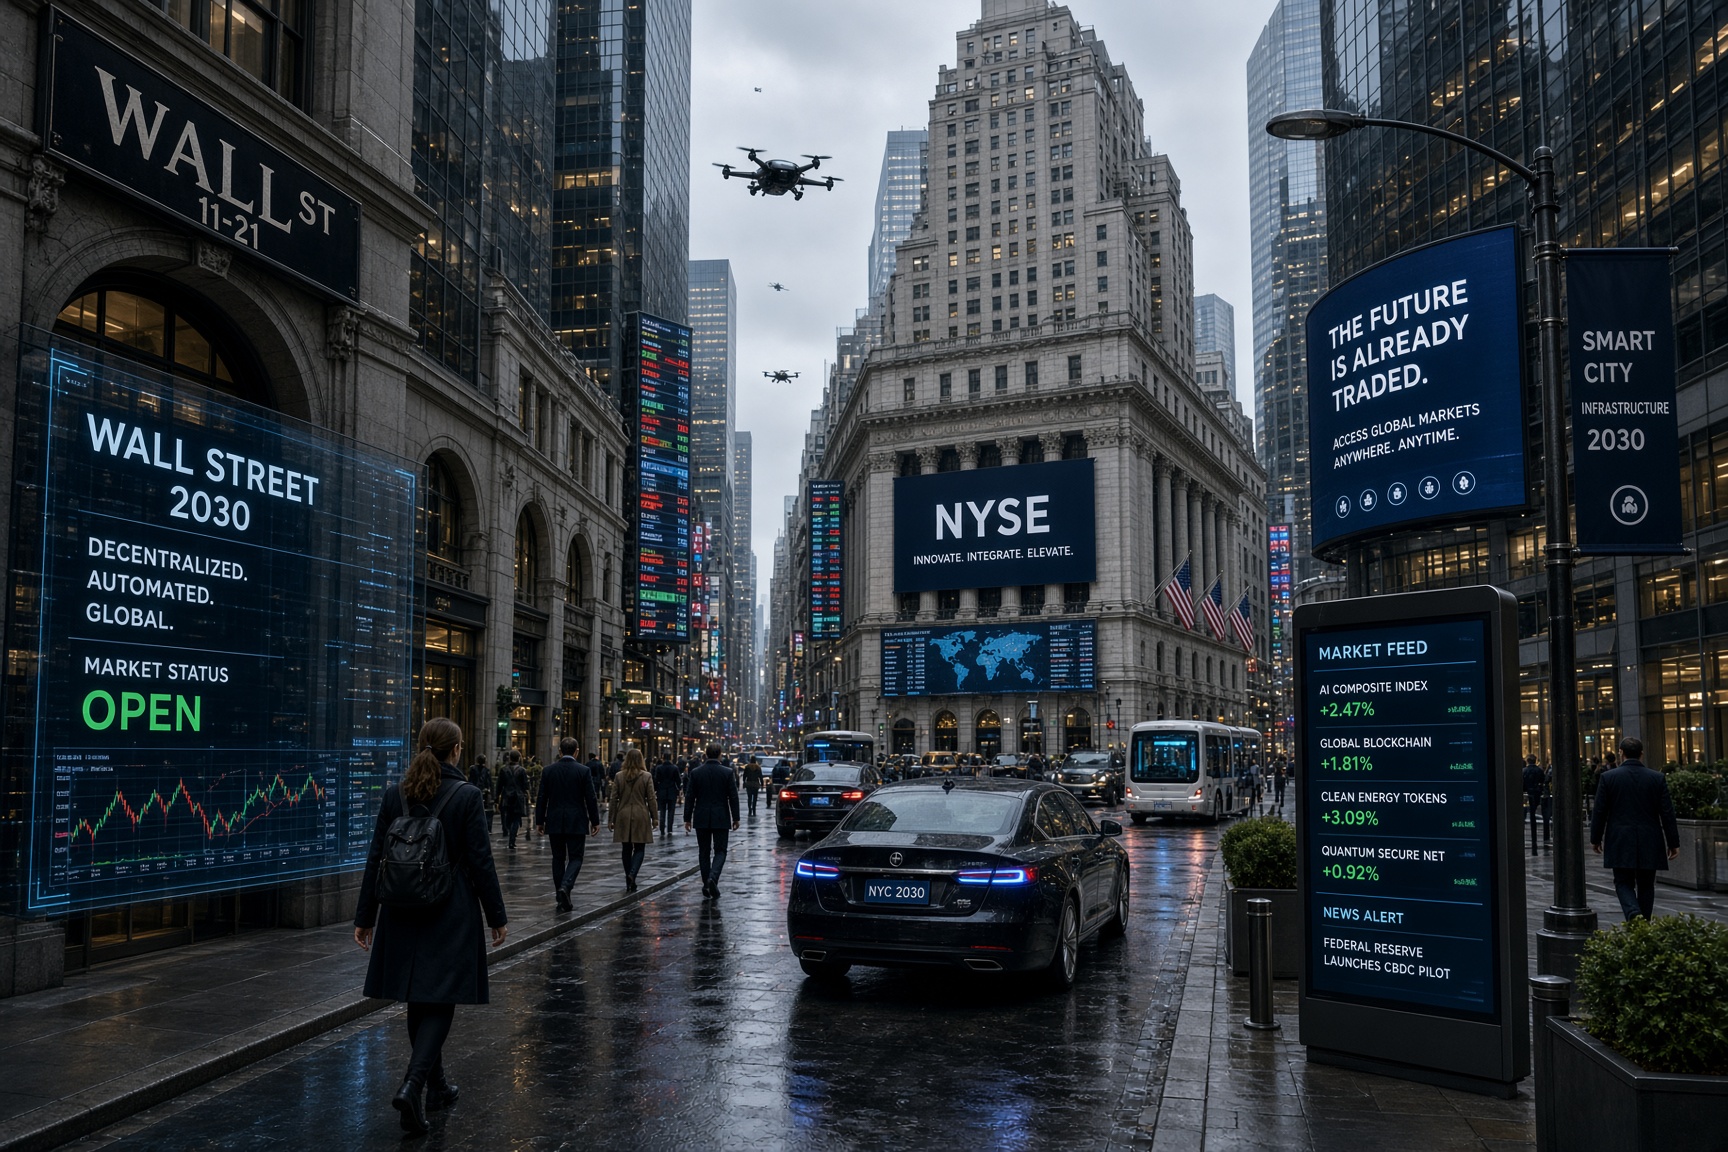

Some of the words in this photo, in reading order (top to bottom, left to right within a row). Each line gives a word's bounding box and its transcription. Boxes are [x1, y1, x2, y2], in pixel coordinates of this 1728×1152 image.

[95, 66, 292, 234] WALL
[298, 191, 335, 235] ST
[199, 197, 259, 249] 11-21
[1329, 317, 1363, 349] THE
[1370, 279, 1467, 331] FUTURE
[1332, 356, 1347, 380] IS
[1353, 314, 1468, 372] ALREADY
[1583, 331, 1655, 351] SMART
[1584, 363, 1633, 383] CITY
[1333, 363, 1427, 412] TRADED.
[1582, 402, 1669, 414] INFRASTRUCTURE
[1334, 429, 1368, 450] ACCESS
[1371, 416, 1415, 437] GLOBAL
[1419, 404, 1480, 425] MARKETS
[1334, 444, 1394, 469] ANYWHERE.
[1399, 428, 1459, 451] ANYTIME.
[1588, 429, 1645, 451] 2030
[87, 413, 194, 475] WALL
[206, 449, 318, 505] STREET
[170, 486, 250, 531] 2030
[936, 495, 1050, 540] NYSE
[89, 537, 248, 581] DECENTRALIZED.
[914, 553, 964, 565] INNOVATE.
[967, 549, 1024, 561] INTEGRATE.
[1027, 546, 1073, 558] ELEVATE.
[87, 570, 214, 605] AUTOMATED.
[87, 603, 173, 630] GLOBAL.
[1319, 643, 1381, 659] MARKET
[1388, 641, 1428, 656] FEED
[85, 657, 162, 678] MARKET
[168, 663, 228, 682] STATUS
[1320, 685, 1329, 694] AI
[1333, 682, 1391, 694] COMPOSITE
[1395, 681, 1428, 691] INDEX
[82, 690, 201, 733] OPEN
[1320, 702, 1374, 717] +2.47%
[1320, 738, 1360, 748] GLOBAL
[1364, 737, 1431, 747] BLOCKCHAIN
[1321, 756, 1372, 770] +1.81%
[1321, 792, 1354, 802] CLEAN
[1359, 792, 1400, 802] ENERGY
[1403, 793, 1447, 803] TOKENS
[1322, 810, 1378, 825] +3.09%
[1322, 846, 1374, 857] QUANTUM
[1378, 849, 1419, 859] SECURE
[1424, 851, 1445, 861] NET
[1323, 864, 1379, 880] +0.92%
[868, 885, 892, 898] NYC
[895, 886, 925, 898] 2030
[1323, 907, 1359, 920] NEWS
[1364, 910, 1404, 924] ALERT
[1324, 938, 1370, 952] FEDERAL
[1375, 944, 1423, 957] RESERVE
[1324, 955, 1380, 971] LAUNCHES
[1384, 962, 1414, 974] CBDC
[1419, 966, 1450, 979] PILOT
